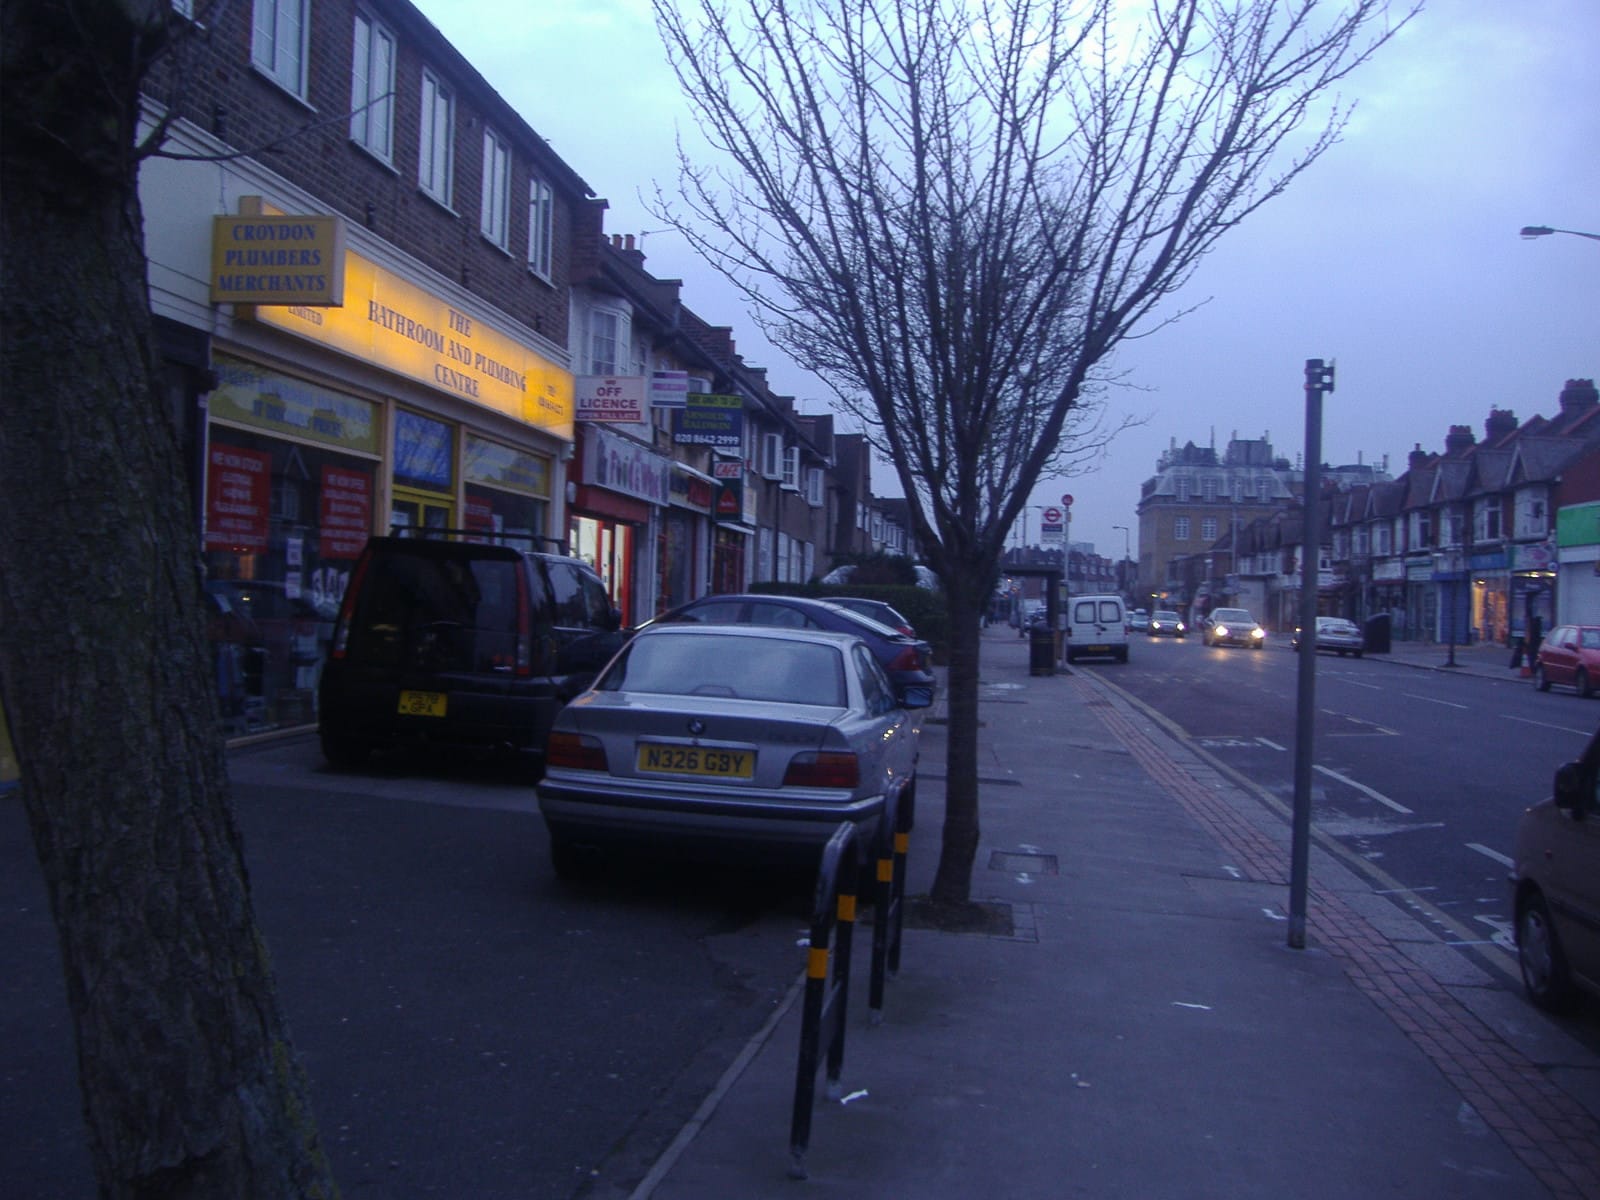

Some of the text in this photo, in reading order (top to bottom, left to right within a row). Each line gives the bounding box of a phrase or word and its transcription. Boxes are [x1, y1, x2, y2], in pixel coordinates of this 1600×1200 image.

[232, 224, 317, 241] CROYDON
[225, 249, 321, 266] PLUMBERS
[218, 274, 327, 292] MERCHANTS
[287, 305, 323, 326] LIMITED
[448, 309, 472, 338] THE
[368, 301, 527, 393] BATHROOM AND PLUMBING
[434, 363, 480, 399] CENTRE
[597, 387, 622, 397] OFF
[580, 399, 638, 409] LICENCE
[675, 433, 691, 443] 020
[716, 463, 741, 477] CAFE
[647, 749, 699, 772] N326
